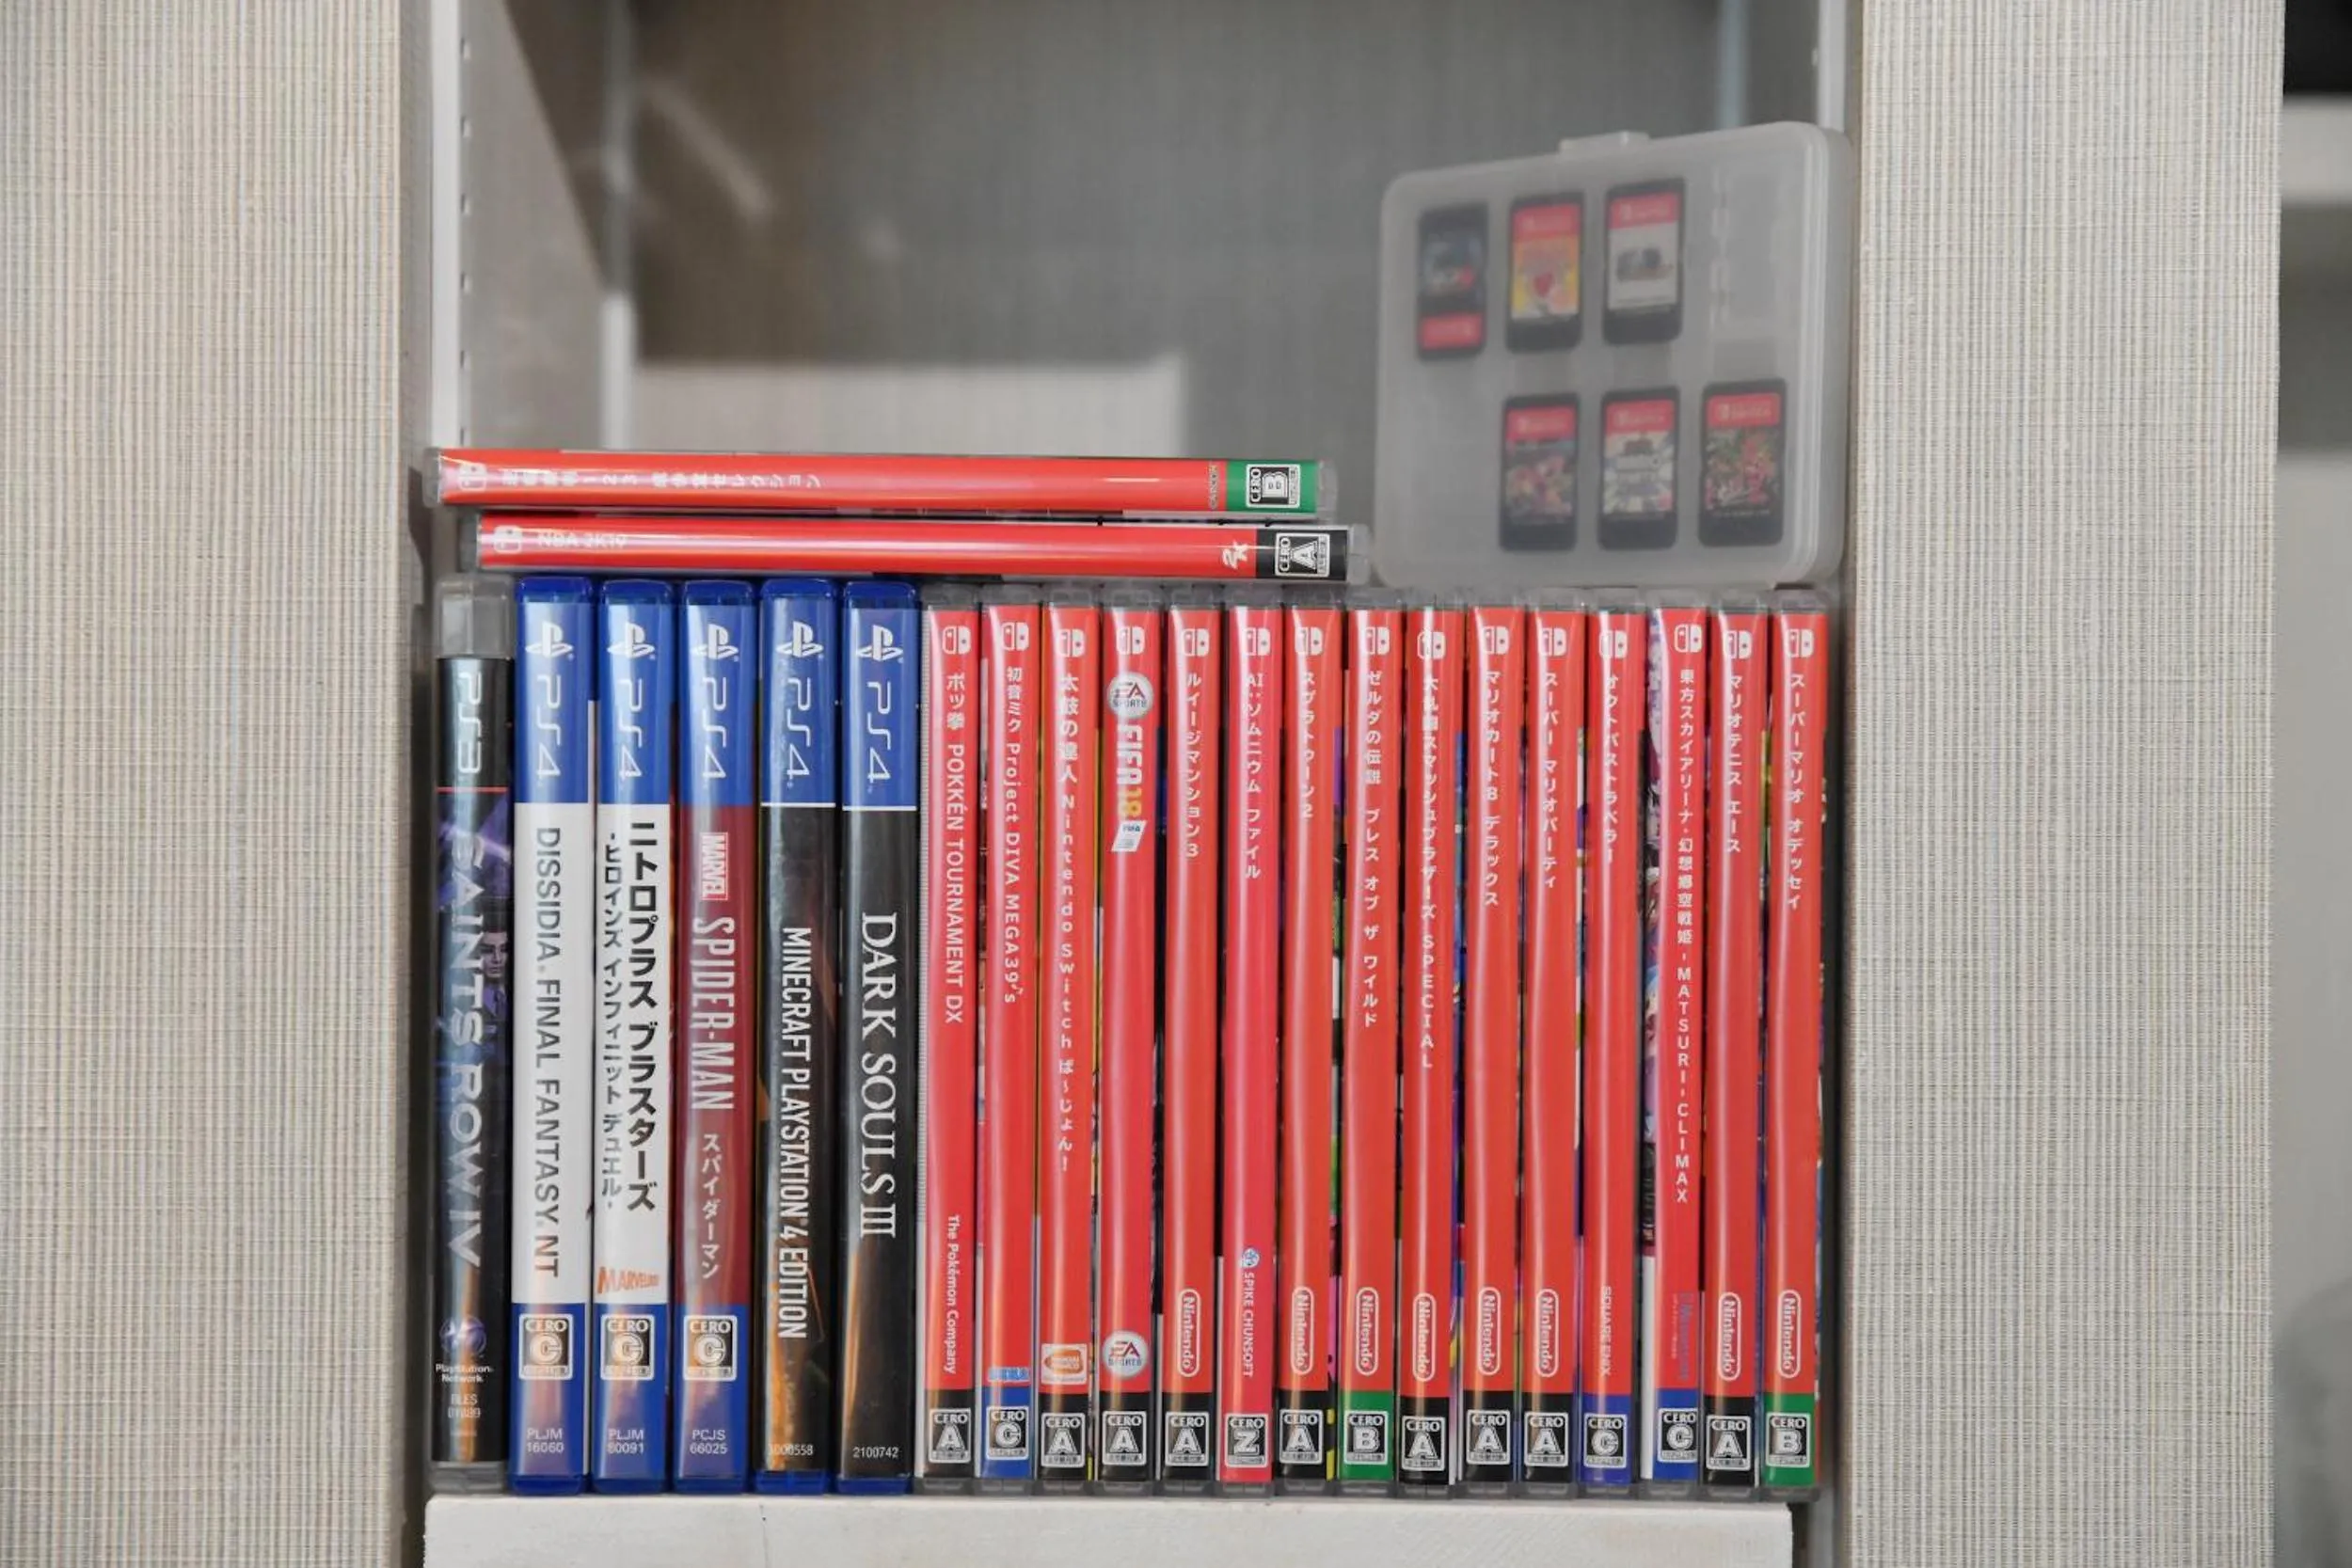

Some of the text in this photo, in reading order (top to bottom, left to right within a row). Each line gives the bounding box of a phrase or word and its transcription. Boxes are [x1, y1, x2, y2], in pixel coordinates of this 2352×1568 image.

[1248, 467, 1262, 502] CERO
[1261, 472, 1289, 499] B
[1279, 536, 1292, 572] CERO
[1290, 539, 1319, 569] A
[458, 671, 482, 773] PS3
[1543, 673, 1558, 747] スーパー
[536, 674, 562, 781] PS4
[618, 678, 644, 781] PS4
[702, 676, 727, 780] PS4
[786, 677, 812, 781] PS4
[866, 680, 891, 784] PS4
[1725, 675, 1742, 853] マリオテニス エース
[946, 744, 966, 832] POKKÉN
[1003, 745, 1022, 824] Project
[1483, 671, 1502, 907] マリオカート8 デラックス
[1787, 673, 1805, 910] スーパーマリオ オデッセイ
[1004, 833, 1021, 885] DIVA
[1245, 810, 1262, 879] ファイル
[1362, 671, 1383, 1028] ゼルダの伝説 ブレス オブ ザ ワイルド
[1059, 795, 1075, 933] Nintendo
[945, 840, 965, 988] TOURNAMENT
[691, 834, 735, 1109] MARVEL SPIDER-MAN
[945, 996, 964, 1024] DX
[1059, 943, 1075, 1049] Switch
[1421, 934, 1436, 1069] SPECIAL
[628, 822, 660, 1212] ニトロプラス ブラスターズ
[449, 833, 483, 1267] SAINTS ROW IV
[534, 827, 563, 1278] DISSIDIA FINAL FANTASY NT
[860, 912, 897, 1239] DARK SOULS III
[778, 927, 812, 1338] MINECRAFT PLAYSTATION 4 EDITION
[700, 1133, 719, 1279] スパイダーマン
[944, 1215, 961, 1373] The Pokémon Company
[526, 1320, 567, 1332] CERO
[608, 1319, 649, 1332] CERO
[690, 1320, 730, 1333] CERO
[1182, 1296, 1196, 1370] Nintendo
[1242, 1272, 1255, 1378] SPIKE CHUNSOFT
[1293, 1293, 1308, 1368] Nintendo
[1359, 1294, 1375, 1369] Nintendo
[1417, 1299, 1431, 1374] Nintendo
[1481, 1292, 1496, 1368] Nintendo
[1539, 1296, 1554, 1370] Nintendo
[1723, 1300, 1738, 1373] Nintendo
[1782, 1297, 1797, 1370] Nintendo
[529, 1332, 563, 1365] C
[612, 1332, 644, 1365] C
[694, 1333, 727, 1365] C
[933, 1413, 968, 1423] CERO
[991, 1410, 1025, 1420] CERO
[1046, 1418, 1081, 1428] CERO
[1107, 1417, 1142, 1426] CERO
[1170, 1417, 1204, 1427] CERO
[1230, 1417, 1264, 1428] CERO
[1283, 1415, 1318, 1425] CERO
[1348, 1415, 1384, 1425] CERO
[1406, 1420, 1440, 1432] CERO
[1470, 1415, 1506, 1425] CERO
[1529, 1418, 1564, 1429] CERO
[1588, 1418, 1623, 1430] CERO
[1662, 1413, 1697, 1424] CERO
[1711, 1420, 1746, 1431] CERO
[1771, 1418, 1805, 1429] CERO
[526, 1428, 564, 1440] PLJM
[526, 1442, 564, 1454] 16060
[609, 1428, 644, 1440] PLJM
[691, 1430, 725, 1441] PCJS
[936, 1422, 965, 1451] A
[994, 1421, 1022, 1448] C
[1048, 1428, 1078, 1455] A
[1109, 1426, 1139, 1453] A
[1172, 1427, 1201, 1454] A
[1233, 1429, 1259, 1454] Z
[1287, 1425, 1314, 1451] A
[1354, 1427, 1380, 1451] B
[1408, 1432, 1437, 1459] A
[1473, 1425, 1502, 1452] A
[1532, 1428, 1561, 1454] A
[1591, 1430, 1619, 1456] C
[1666, 1423, 1693, 1450] C
[1714, 1432, 1743, 1458] A
[1774, 1429, 1803, 1455] B
[851, 1446, 899, 1459] 2100742
